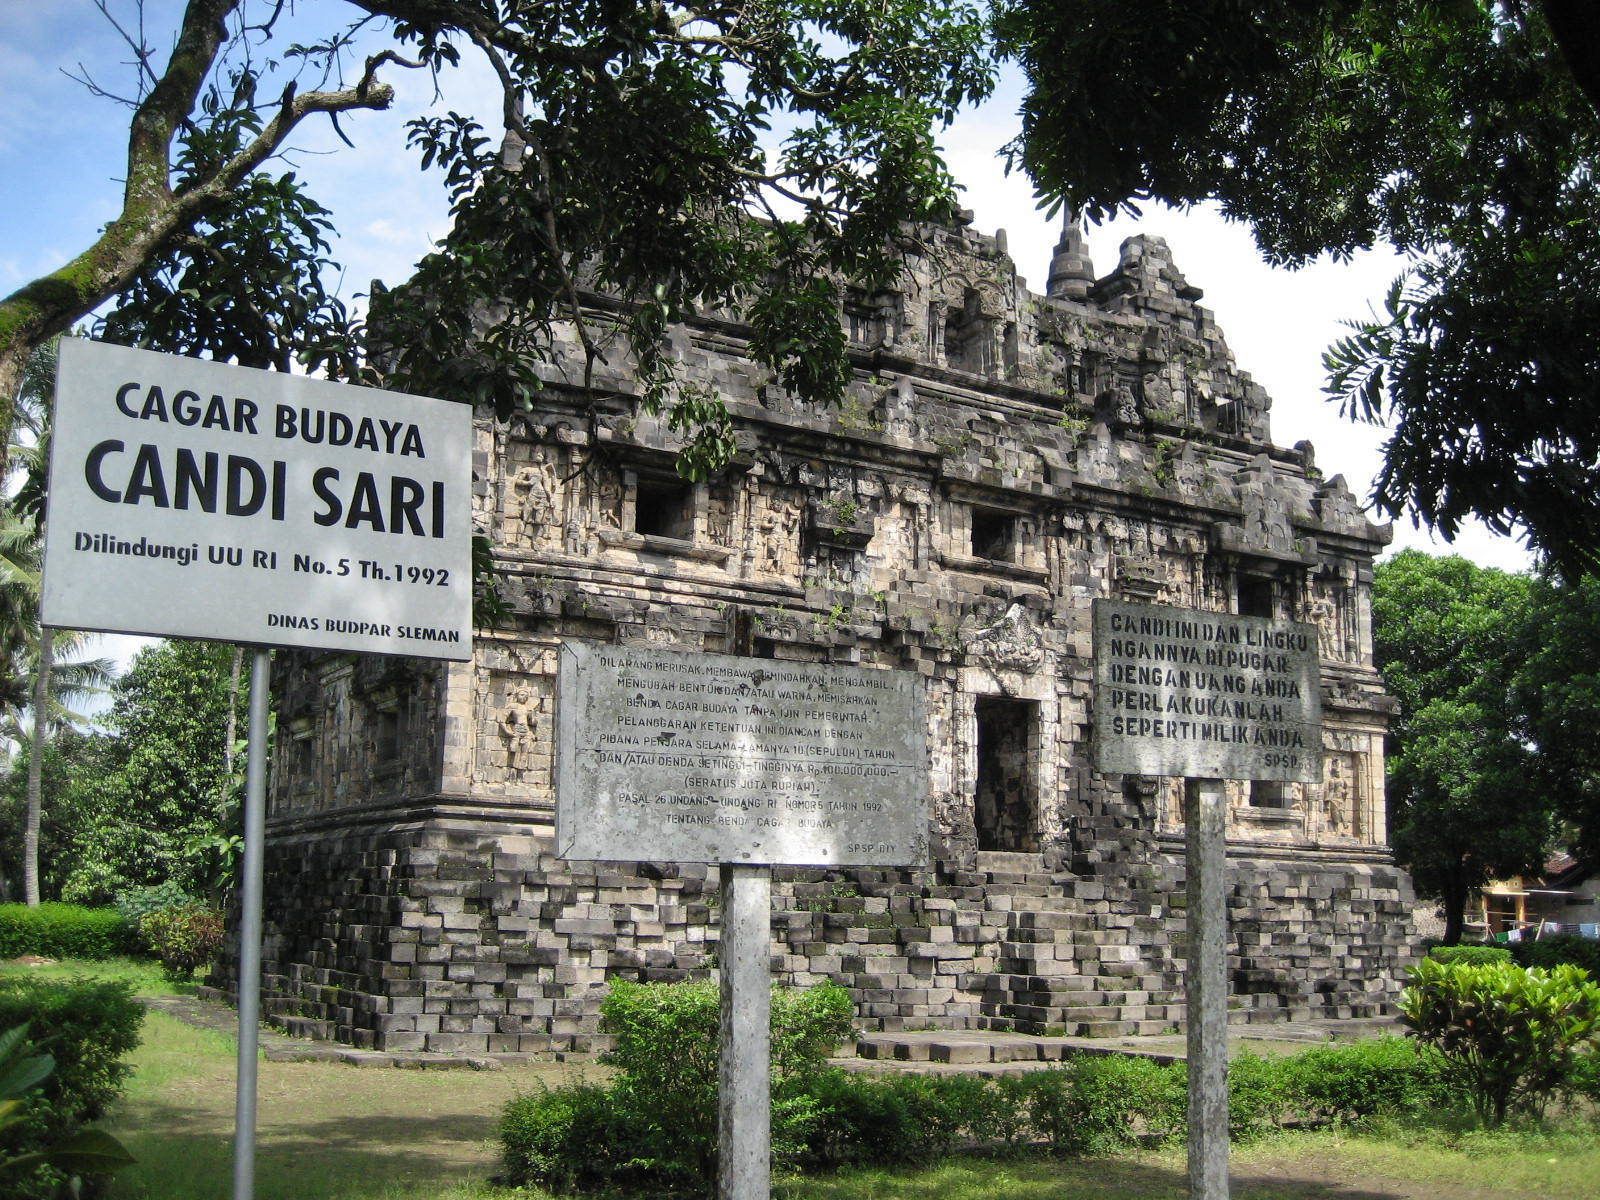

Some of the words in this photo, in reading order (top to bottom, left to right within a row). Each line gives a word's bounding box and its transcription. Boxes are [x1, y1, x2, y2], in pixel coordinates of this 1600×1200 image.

[116, 382, 259, 435] CAGAR
[275, 404, 426, 459] BUDAYA
[84, 439, 286, 521] CANDI
[313, 466, 445, 539] SARI
[74, 531, 199, 567] Dilindungi
[208, 545, 243, 567] UU
[252, 550, 277, 570] RI
[267, 613, 319, 632] DINAS
[324, 619, 391, 638] BUDPAR
[396, 625, 460, 644] SLEMAN
[1111, 613, 1171, 637] CANDI
[1175, 620, 1199, 641] INI
[1203, 623, 1240, 645] DAN
[1246, 628, 1308, 652] LINGKU
[1111, 638, 1201, 665] NGANNYA
[617, 678, 675, 692] MENGUBAH
[679, 683, 723, 694] BENTUK
[817, 693, 878, 706] MEMISAHKAN
[1111, 663, 1191, 688] DENGAN
[1195, 672, 1246, 694] UANG
[1251, 678, 1301, 699] ANDA
[626, 697, 662, 709] BENDA
[665, 700, 698, 712] CAGAR
[702, 703, 738, 715] BUDAYA
[744, 706, 776, 717] TANPA
[780, 709, 800, 718] IJIN
[1112, 689, 1283, 722] PERLAKUKANLAH
[617, 715, 697, 730] PELANGGARAN
[700, 721, 761, 735] KETENTUAN
[765, 726, 776, 735] INI
[779, 726, 821, 738] DIANCAM
[824, 729, 863, 741] DENGAN
[1112, 716, 1197, 740] SEPERTI
[1201, 723, 1249, 744] MILIK
[1254, 728, 1304, 748] ANDA
[600, 733, 640, 745] PIDANA
[643, 736, 693, 749] PENJARA
[864, 749, 896, 760] TAHUN
[658, 756, 695, 767] DENDA
[1264, 753, 1298, 769] SPSP
[684, 775, 737, 789] (SERATUS
[740, 780, 767, 790] JUTA
[618, 792, 650, 804] PASAL
[654, 794, 667, 804] 26
[767, 799, 777, 809] RI
[828, 801, 858, 811] TAHUN
[863, 802, 882, 812] 1992
[666, 814, 710, 824] TENTANG
[848, 843, 874, 853] SPSP
